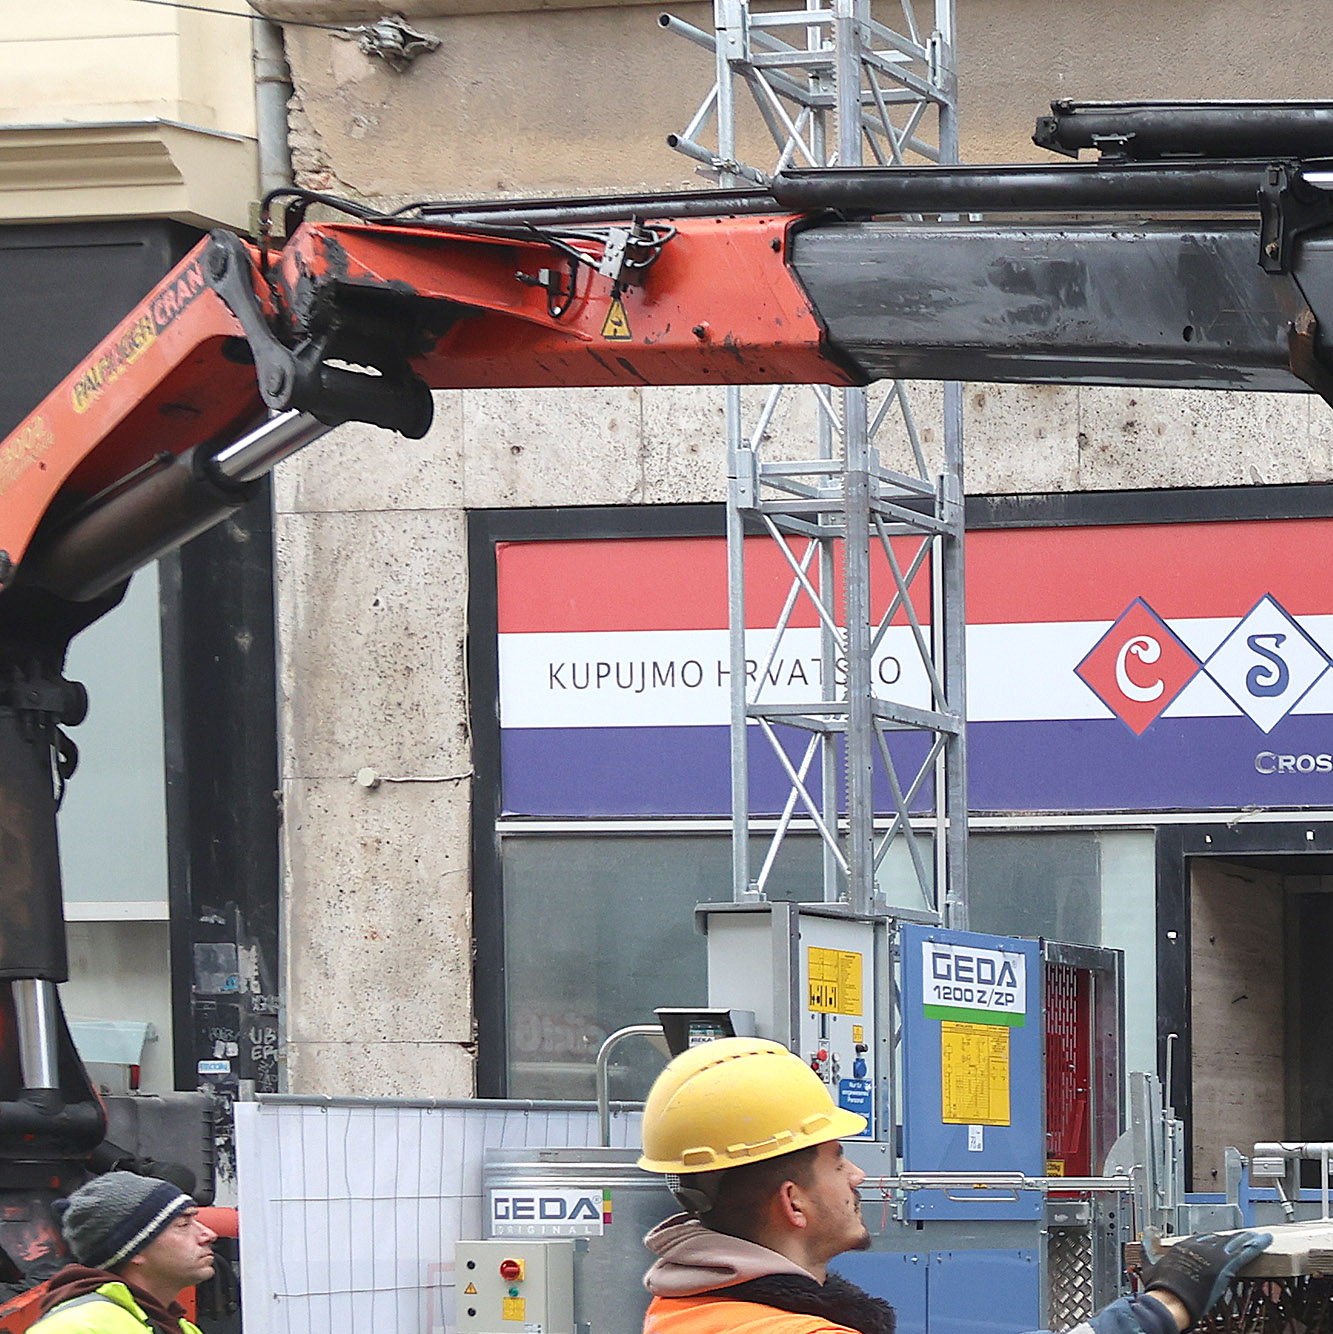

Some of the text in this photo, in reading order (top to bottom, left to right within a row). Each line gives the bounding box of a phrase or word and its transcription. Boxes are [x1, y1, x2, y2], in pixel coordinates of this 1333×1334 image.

[153, 260, 207, 326] CRAN
[549, 660, 703, 693] KUPUJMO
[932, 952, 1017, 989] GEDA
[933, 985, 974, 1003] 1200
[494, 1197, 600, 1220] GEDA
